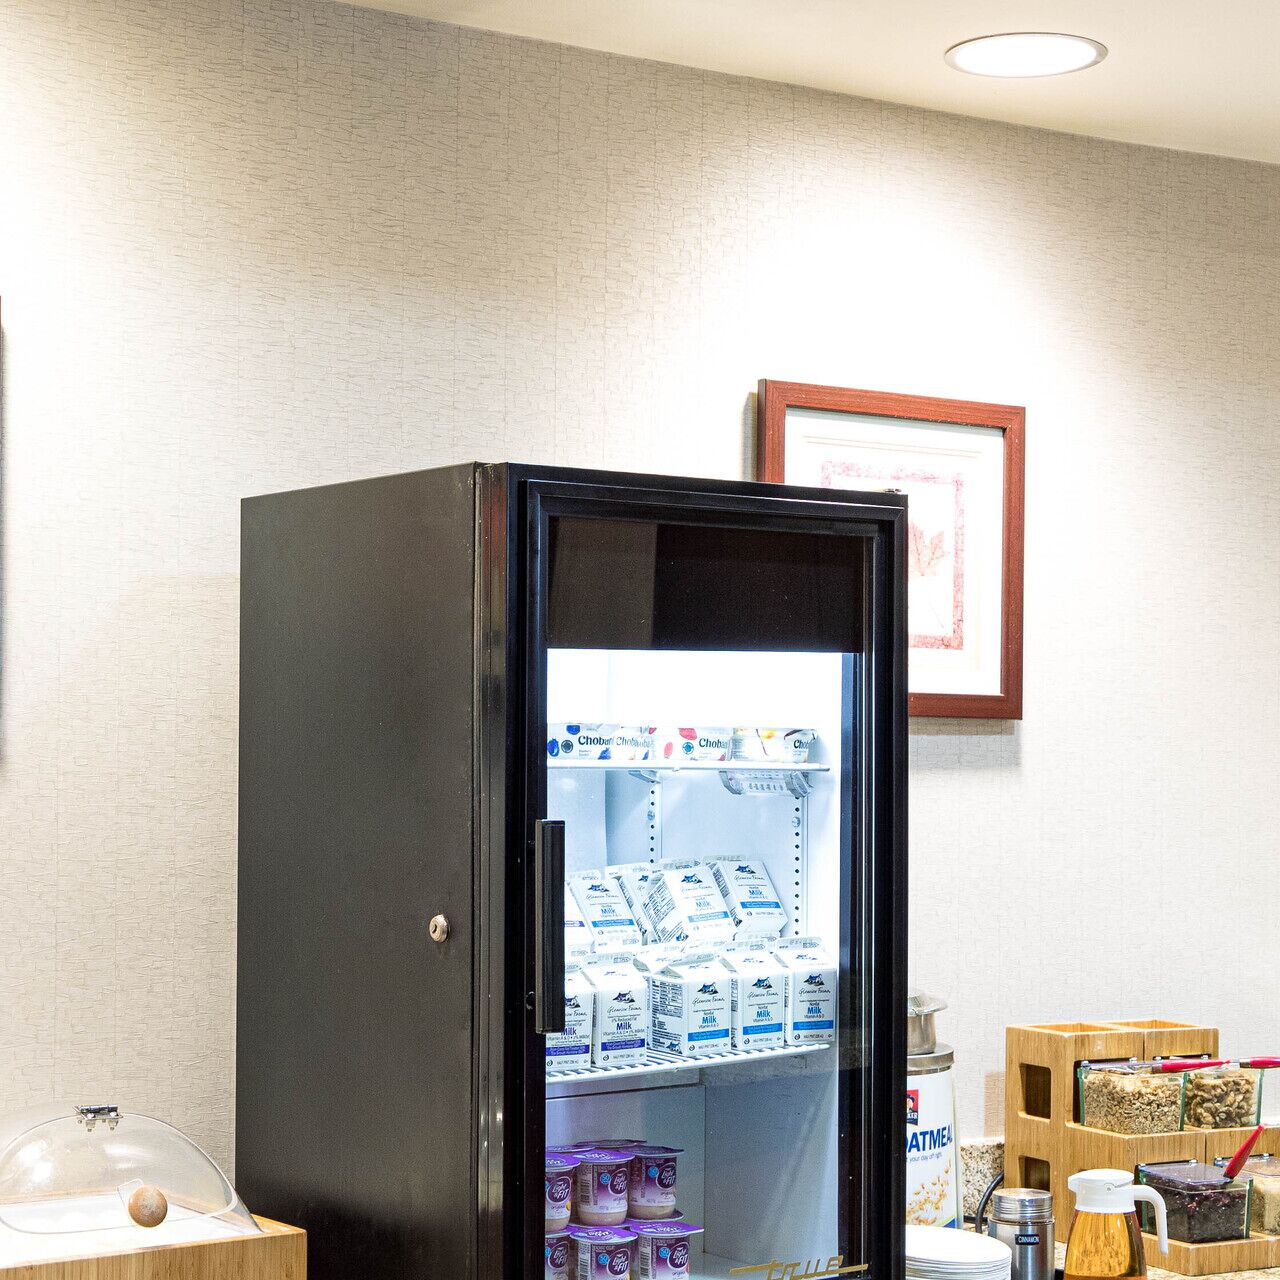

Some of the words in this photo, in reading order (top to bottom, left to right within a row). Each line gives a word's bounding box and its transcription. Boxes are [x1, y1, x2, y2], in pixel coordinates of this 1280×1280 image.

[757, 1010, 771, 1018] Milk
[807, 1007, 822, 1015] Milk
[702, 1016, 717, 1024] Milk
[616, 1022, 632, 1031] Milk
[906, 1124, 953, 1153] ATMEA
